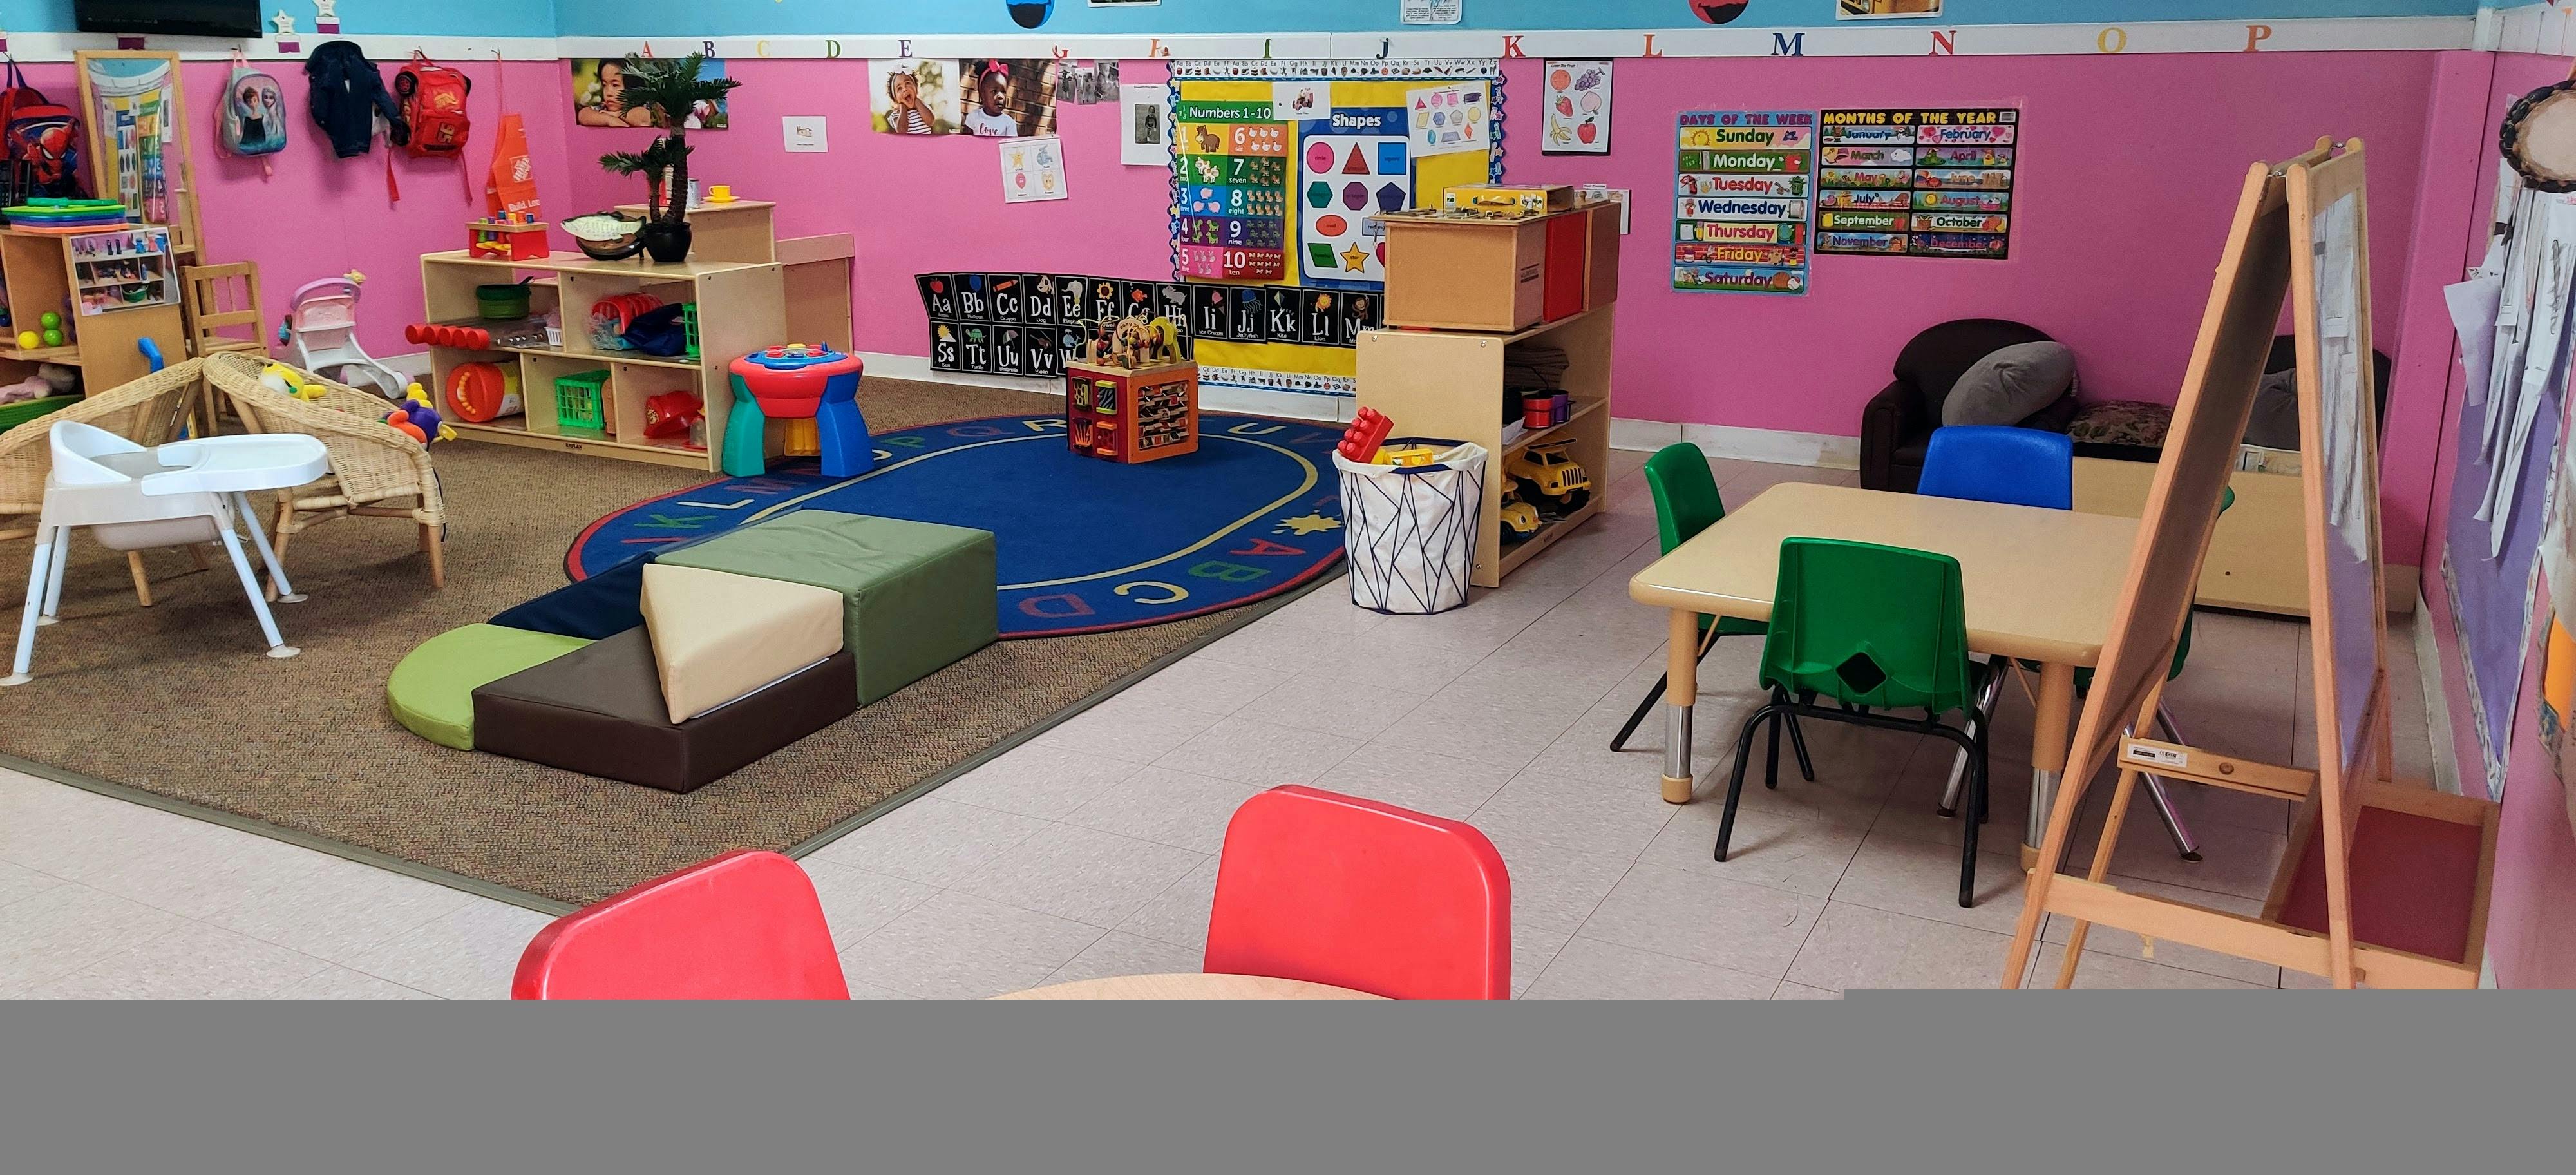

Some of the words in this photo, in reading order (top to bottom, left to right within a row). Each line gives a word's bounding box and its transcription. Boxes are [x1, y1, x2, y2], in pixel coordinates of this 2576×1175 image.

[641, 41, 654, 58] A
[703, 41, 715, 58] B
[756, 39, 771, 57] C
[826, 39, 842, 58] D
[898, 39, 913, 58] E
[1376, 37, 1390, 59] J
[1502, 35, 1526, 59] K
[1643, 34, 1663, 58] L
[1771, 33, 1805, 57] M
[1929, 30, 1957, 57] N
[2096, 27, 2128, 54] O
[2243, 24, 2273, 52] P
[1189, 106, 1240, 119] Numbers
[1243, 107, 1271, 119] 1-10
[1332, 113, 1381, 129] Shapes
[1680, 114, 1716, 126] DAYS
[1721, 114, 1739, 125] OF
[1745, 113, 1770, 125] THE
[1776, 113, 1813, 126] WEEK
[1823, 112, 1886, 124] MONTHS
[1892, 112, 1913, 124] OF
[1920, 112, 1949, 124] THE
[1956, 112, 1996, 124] YEAR
[1235, 127, 1245, 145] 6
[1716, 128, 1775, 146] Sunday
[1846, 129, 1891, 140] January
[1940, 129, 1991, 140] February
[1713, 153, 1776, 171] Monday
[1850, 150, 1884, 161] March
[1949, 150, 1977, 163] April
[1180, 157, 1188, 175] 2
[1233, 158, 1244, 176] 7
[1712, 177, 1774, 195] Tuesday
[1854, 172, 1879, 185] May
[1180, 187, 1188, 205] 3
[1231, 189, 1243, 207] 8
[1853, 193, 1875, 206] July
[1940, 195, 1981, 207] August
[1228, 207, 1245, 216] eight
[1698, 200, 1786, 218] Wednesday
[1181, 218, 1189, 235] 4
[1229, 220, 1242, 238] 9
[1833, 215, 1895, 226] September
[1936, 216, 1982, 227] October
[1706, 224, 1775, 242] Thursday
[1832, 236, 1888, 247] November
[1931, 236, 1988, 249] December
[1182, 248, 1189, 265] 5
[1224, 251, 1246, 269] 10
[1717, 247, 1763, 263] Friday
[1705, 271, 1773, 289] Saturday
[932, 293, 952, 314] Aa
[961, 291, 985, 314] Bb
[996, 292, 1018, 316] Cc
[1030, 296, 1052, 317] Dd
[1062, 295, 1081, 318] Ee
[1204, 306, 1216, 330] Ii
[1237, 310, 1254, 333] Jj
[1270, 307, 1296, 332] Kk
[1312, 312, 1329, 336] Ll
[938, 342, 954, 363] Ss
[965, 343, 987, 365] Tt
[998, 345, 1019, 367] Uu
[1030, 348, 1054, 370] Vv
[676, 498, 755, 510] L
[1229, 538, 1307, 556] A
[1188, 560, 1273, 582] B
[1112, 580, 1190, 604] C
[1018, 593, 1096, 618] D
